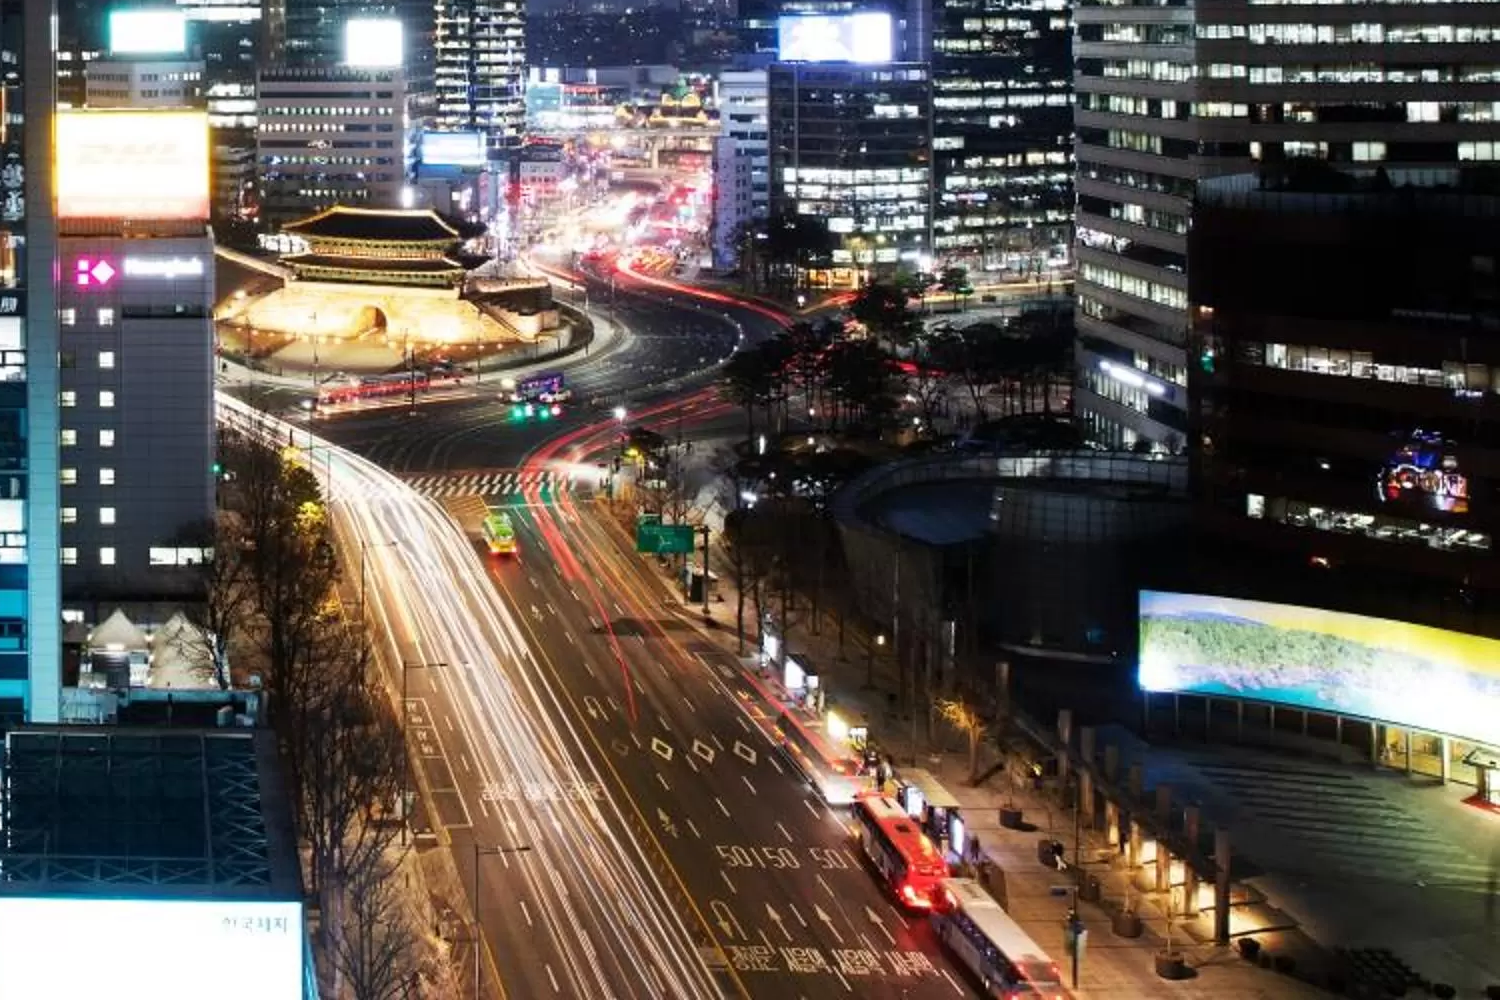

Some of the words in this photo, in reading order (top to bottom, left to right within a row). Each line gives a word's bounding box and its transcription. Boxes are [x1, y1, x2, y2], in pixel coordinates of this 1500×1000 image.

[716, 845, 753, 867] 50
[762, 847, 801, 869] 50
[808, 847, 849, 869] 50
